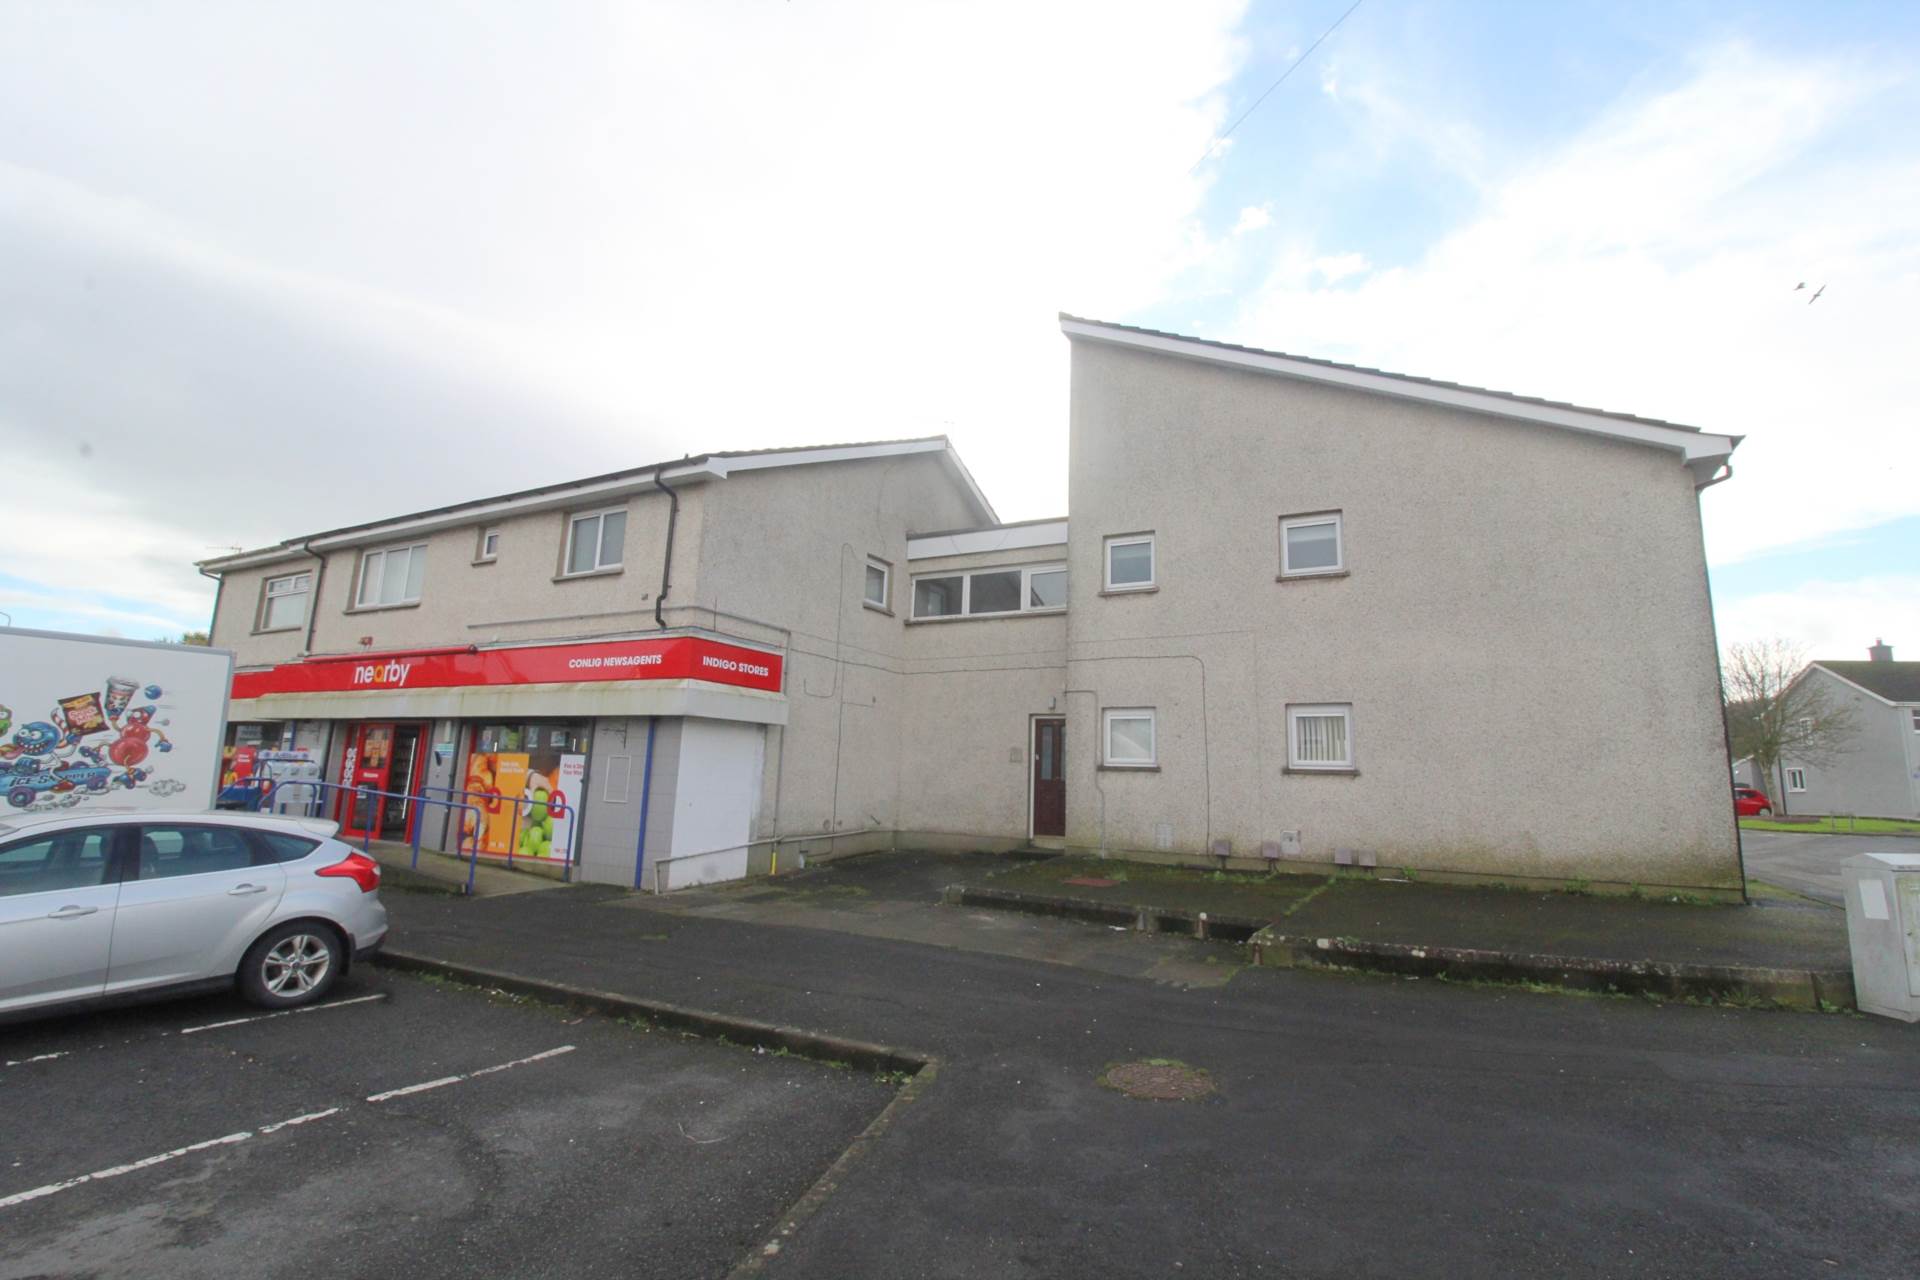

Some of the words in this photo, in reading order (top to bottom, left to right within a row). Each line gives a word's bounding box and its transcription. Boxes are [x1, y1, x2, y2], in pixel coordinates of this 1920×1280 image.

[354, 659, 410, 686] nearby
[568, 657, 602, 669] CONLIG
[603, 654, 663, 667] NEWSAGENTS
[702, 655, 737, 671] INDIGO
[738, 662, 769, 677] STORES
